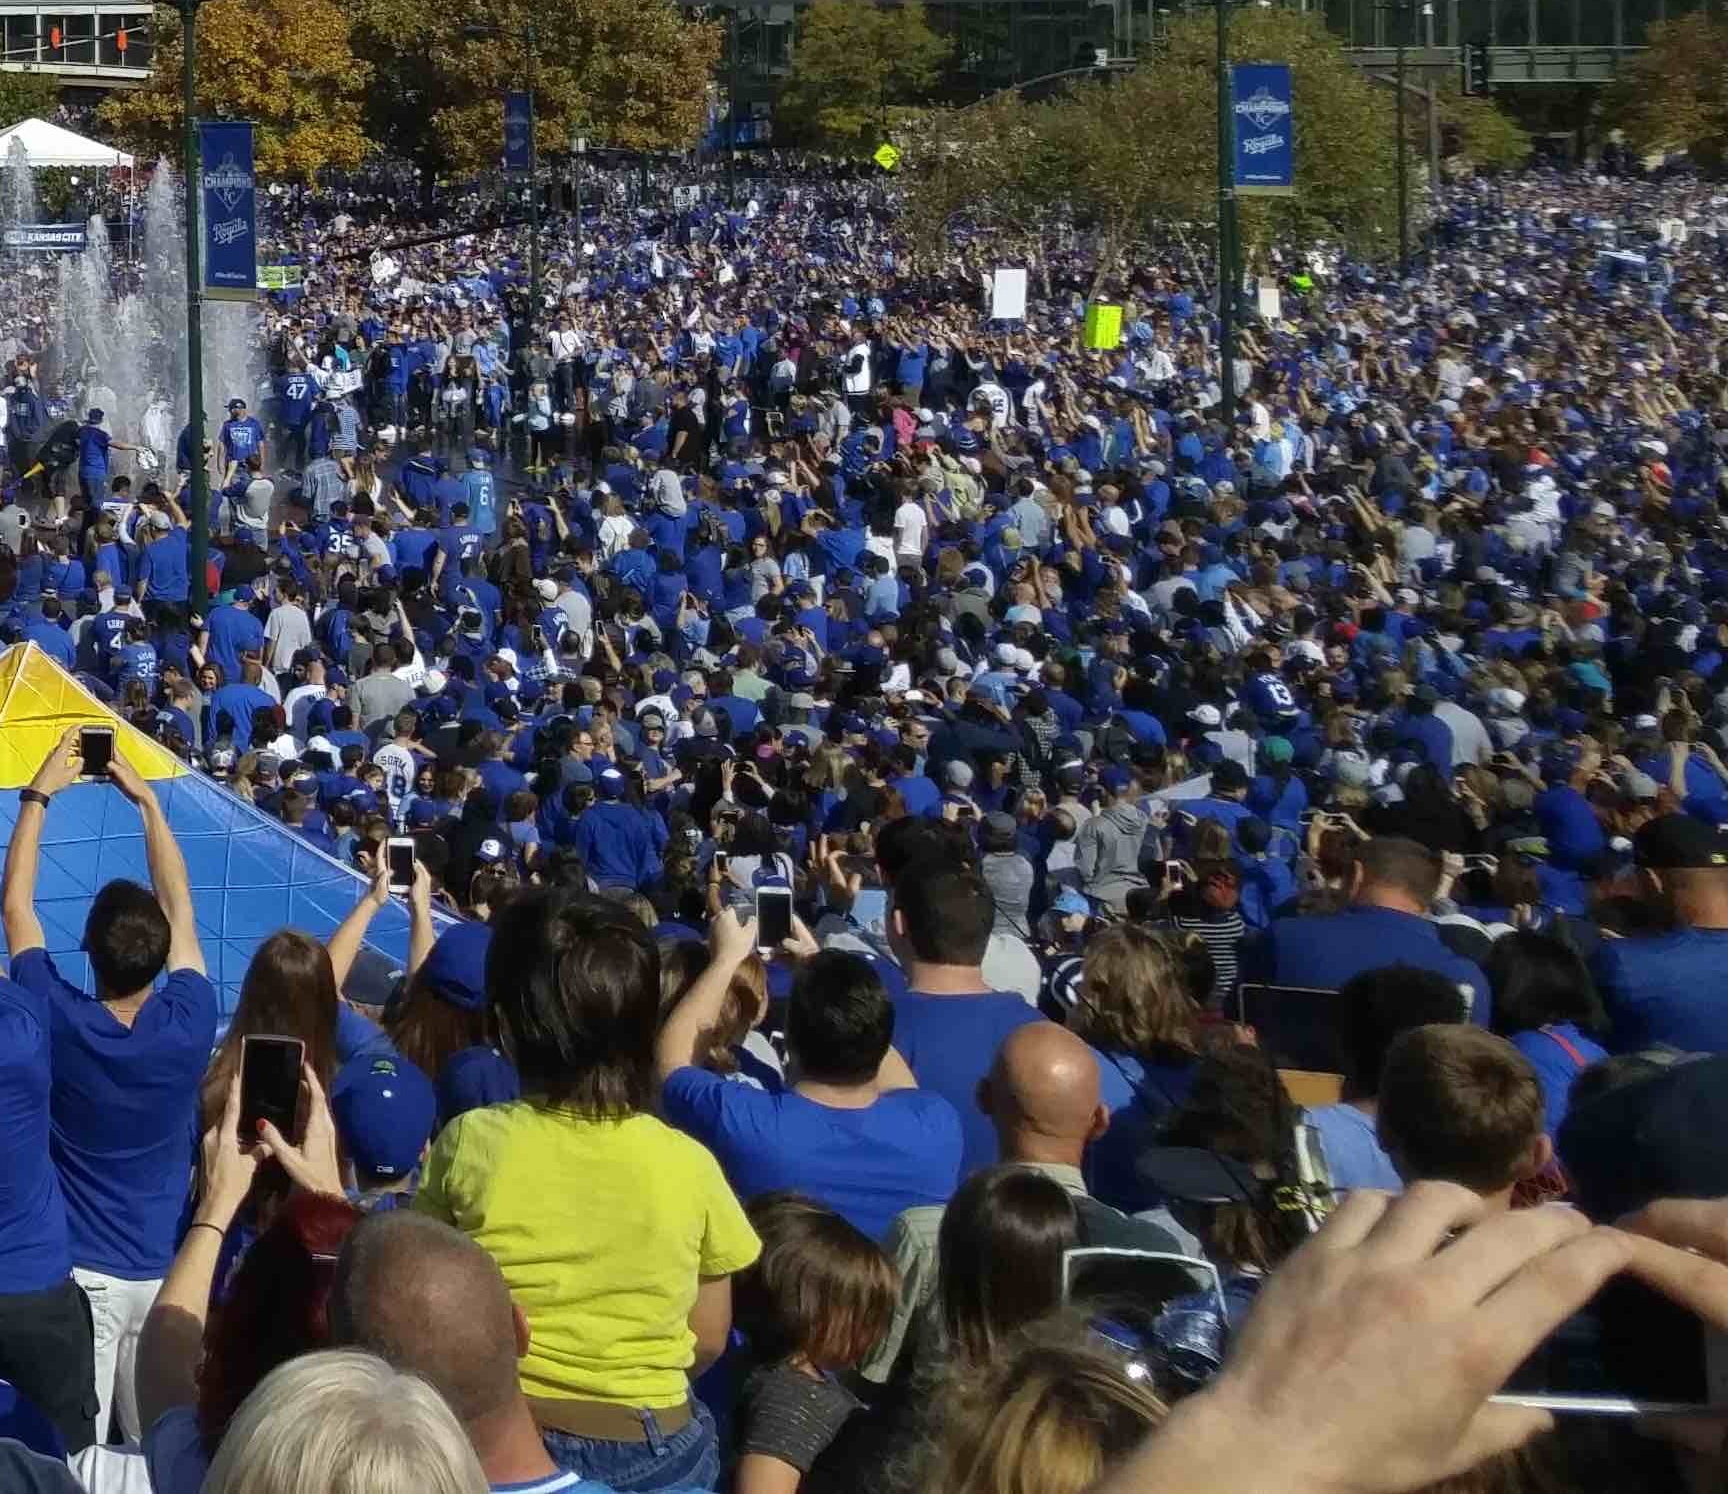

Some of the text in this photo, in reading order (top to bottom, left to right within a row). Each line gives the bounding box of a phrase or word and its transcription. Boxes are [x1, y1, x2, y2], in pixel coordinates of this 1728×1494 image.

[204, 177, 252, 188] CHAMPIONS
[62, 233, 82, 242] CITY
[212, 217, 248, 245] Royals
[287, 383, 307, 400] 47
[329, 534, 352, 553] 35
[110, 631, 122, 649] 4
[392, 775, 406, 798] 8
